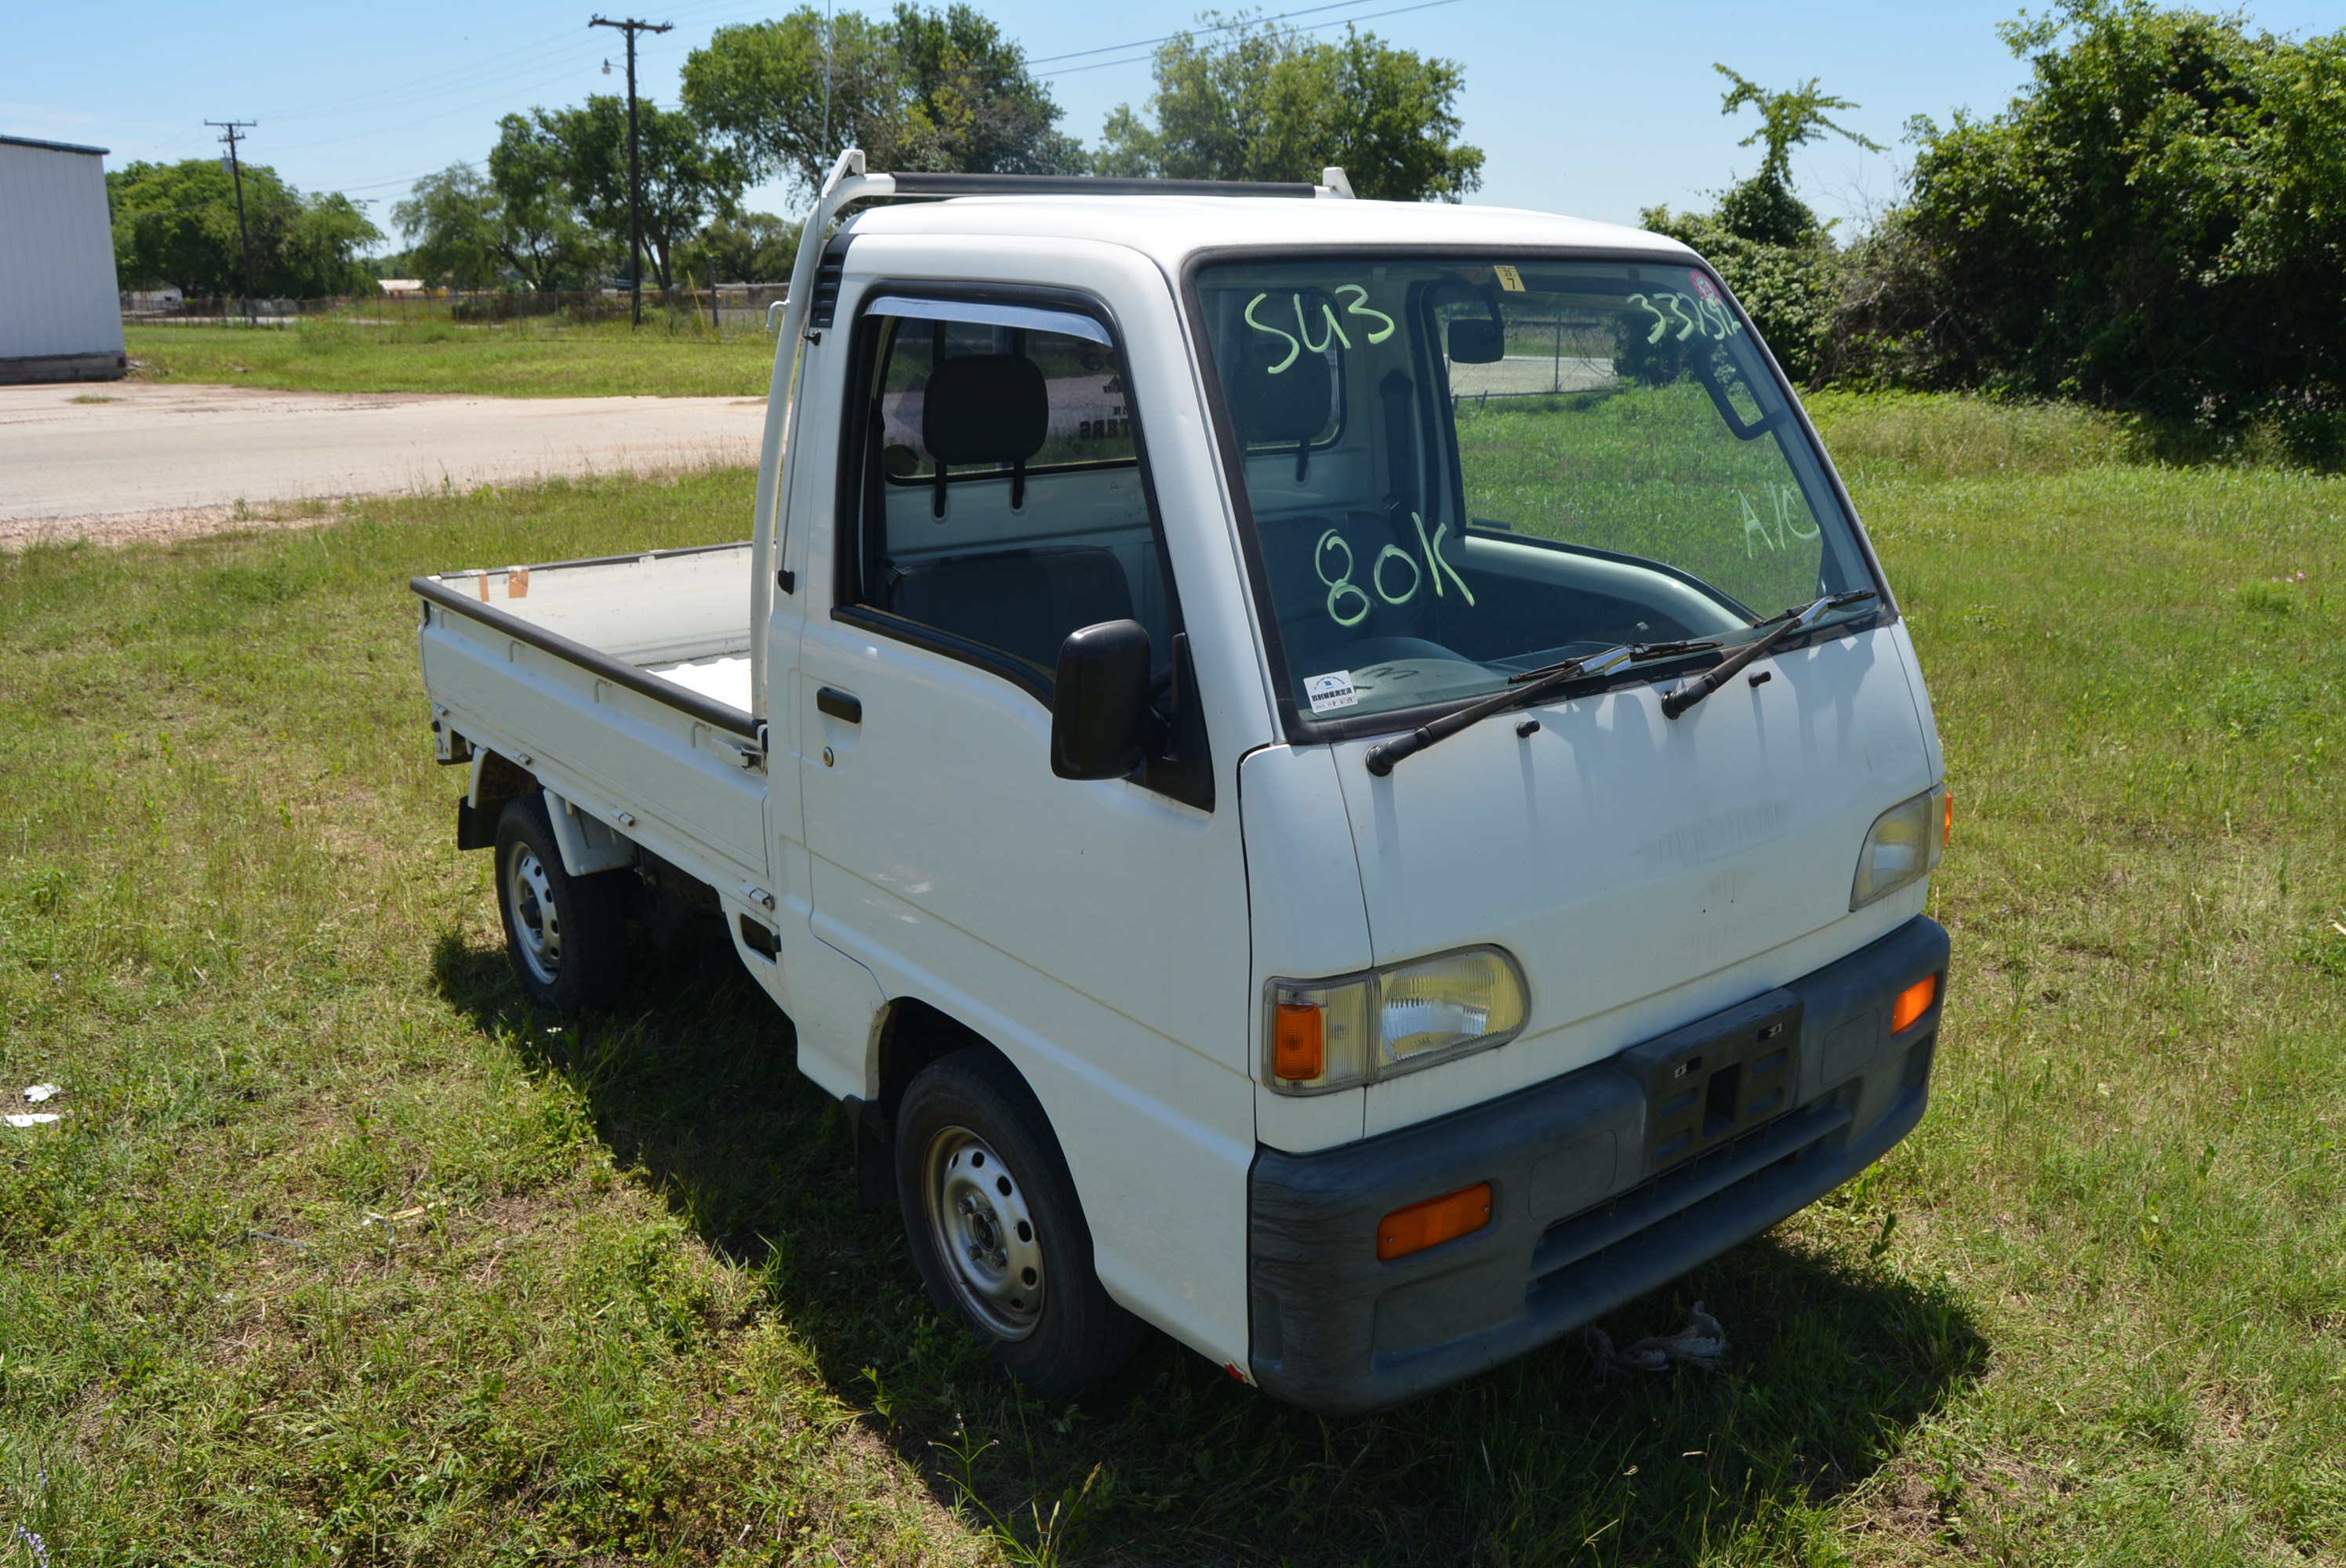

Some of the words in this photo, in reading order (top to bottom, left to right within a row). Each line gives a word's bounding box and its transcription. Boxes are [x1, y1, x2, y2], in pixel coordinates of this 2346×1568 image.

[1507, 277, 1516, 290] 7
[1738, 480, 1821, 560] A/C
[1315, 511, 1475, 626] 80K
